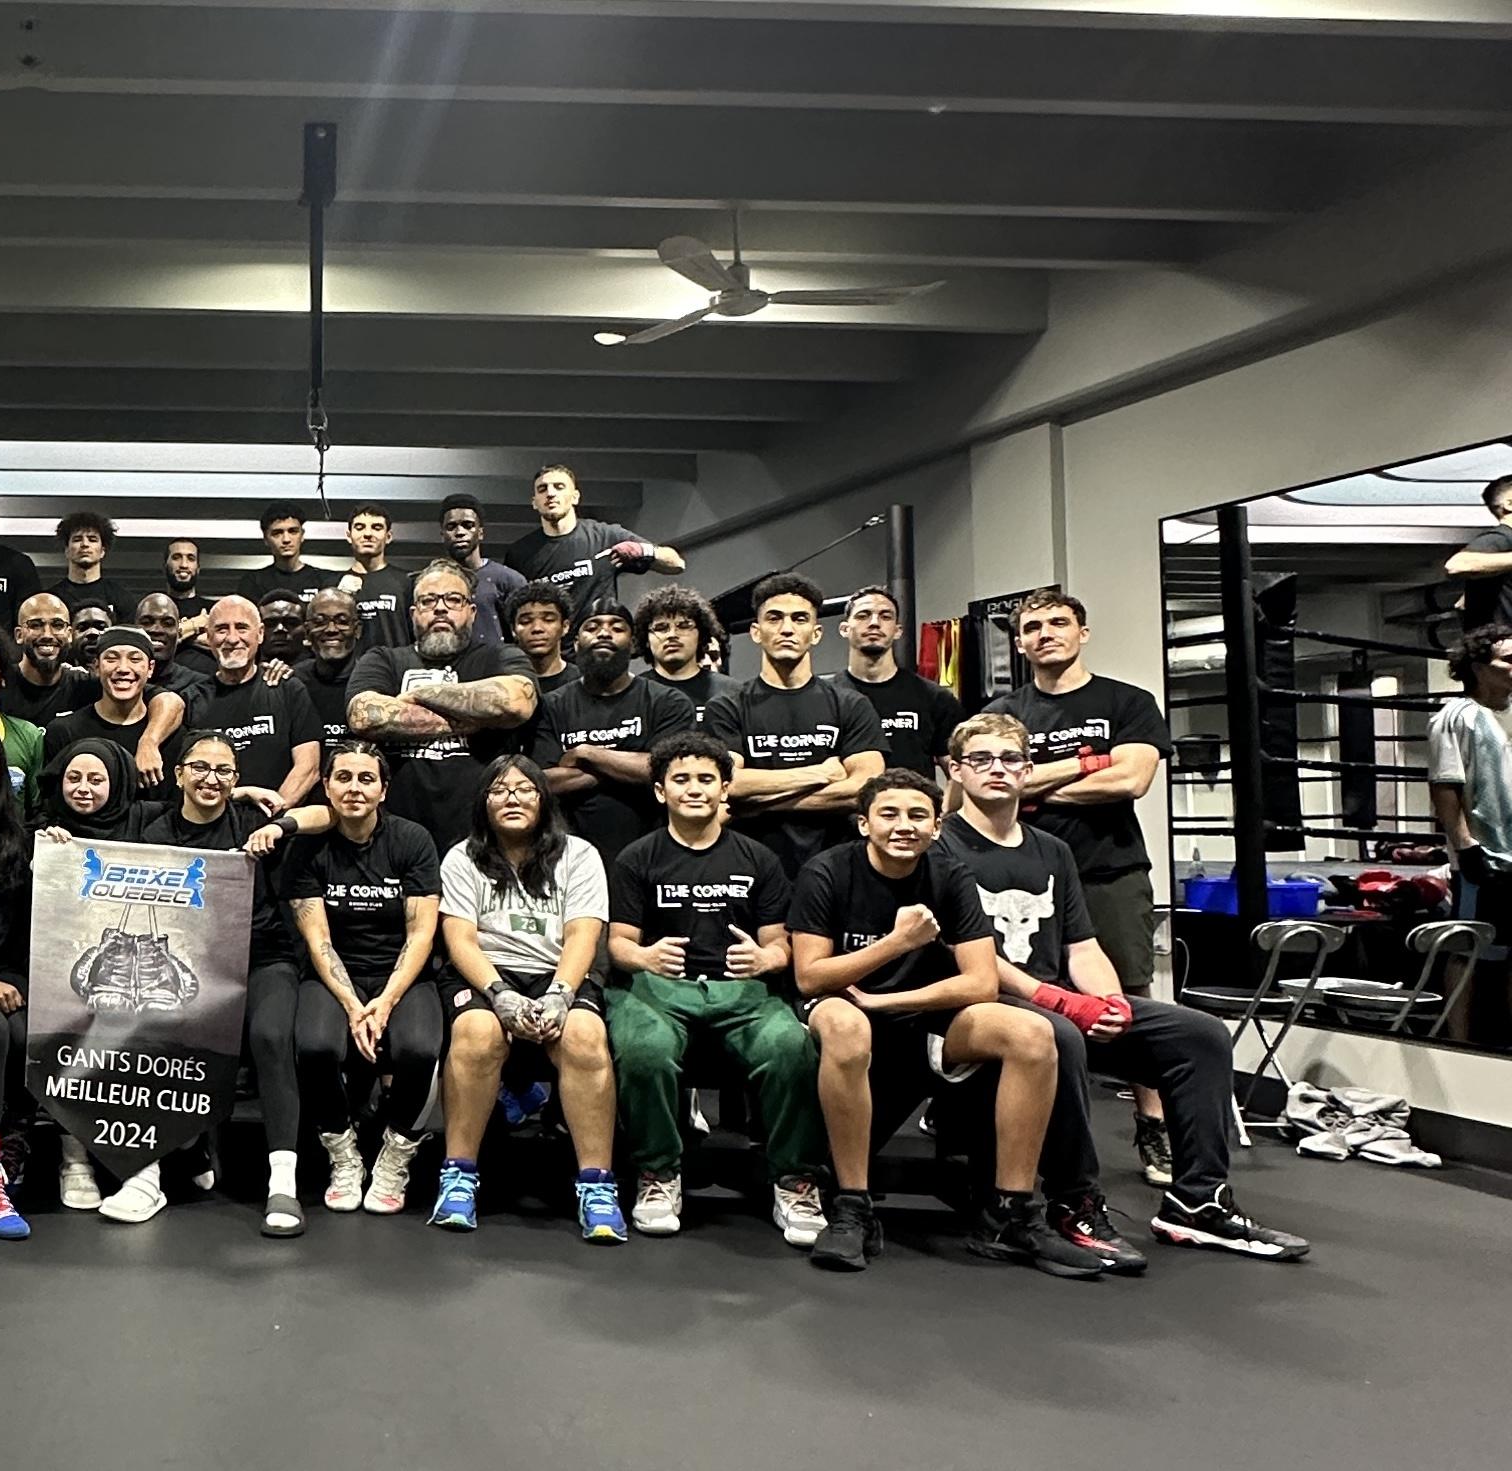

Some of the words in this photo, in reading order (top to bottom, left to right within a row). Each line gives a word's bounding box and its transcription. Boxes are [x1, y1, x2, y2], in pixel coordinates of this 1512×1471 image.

[225, 722, 270, 739] CORNER
[881, 718, 914, 729] RNER
[567, 730, 588, 744] THE
[755, 735, 779, 748] THE
[780, 734, 833, 748] CORNER
[1049, 726, 1104, 742] CORNER
[664, 884, 690, 898] THE
[692, 884, 749, 898] CORNER
[851, 932, 880, 948] THE
[56, 1045, 131, 1073] GANTS
[136, 1056, 207, 1082] DORÉS
[45, 1075, 151, 1108] MEILLEUR
[156, 1089, 211, 1115] CLUB
[93, 1118, 158, 1150] 2024
